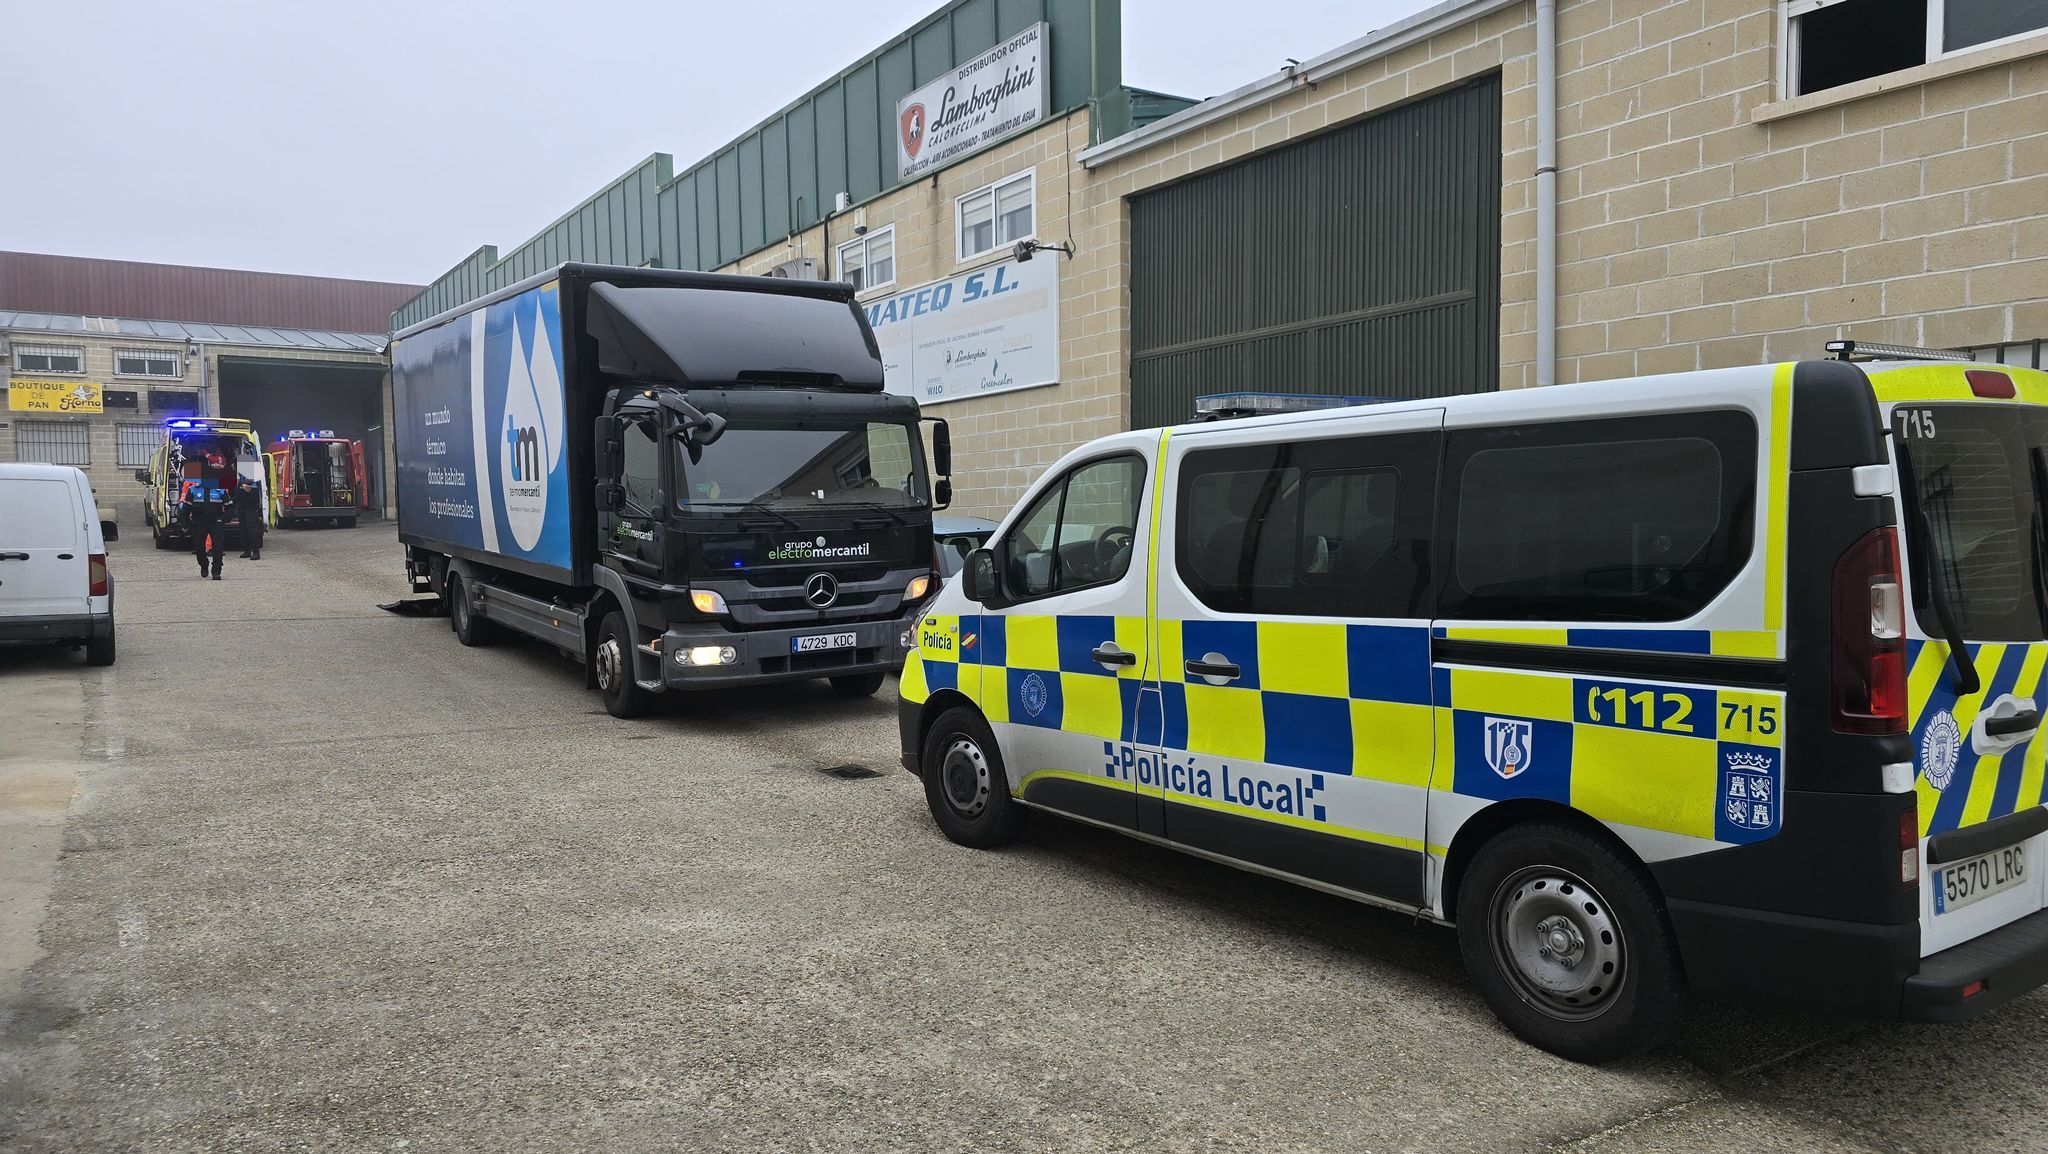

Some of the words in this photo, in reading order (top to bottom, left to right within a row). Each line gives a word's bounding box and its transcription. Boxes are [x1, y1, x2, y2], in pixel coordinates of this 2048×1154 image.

[958, 46, 1008, 81] DISTRIBUIDOR
[1008, 29, 1038, 54] OFICIAL
[930, 55, 1037, 133] Lamborghini
[928, 111, 987, 149] CALORECLIMA
[903, 156, 930, 177] CALEFACCIÓN
[932, 151, 942, 165] AIRE
[941, 134, 978, 161] ACONDICIONADO
[981, 119, 1013, 142] TRATAMIENTO
[1012, 114, 1021, 128] DEL
[1021, 107, 1036, 125] AGUA
[962, 265, 1019, 304] S.L.
[954, 347, 988, 363] Lamborghini
[10, 382, 66, 391] BOUTIQUE
[980, 373, 1014, 390] Greencalor
[28, 401, 49, 409] PAN
[31, 392, 45, 400] DE
[59, 398, 102, 411] Horno
[424, 412, 432, 426] un
[432, 405, 451, 425] mundo
[1896, 409, 1936, 439] 715
[426, 437, 447, 455] térmico
[427, 467, 444, 485] donde
[444, 467, 466, 486] habitan
[428, 497, 437, 514] los
[437, 498, 475, 519] profesionales
[768, 542, 870, 560] electromercantil
[784, 541, 813, 552] grupo
[800, 636, 828, 651] 4729
[833, 634, 854, 647] KDC
[923, 631, 952, 651] Policía
[1601, 687, 1694, 733] 112
[1720, 702, 1777, 735] 715
[1120, 745, 1213, 798] Policía
[1222, 765, 1304, 817] Local
[1945, 857, 1990, 902] 5570
[1994, 846, 2024, 885] LRC
